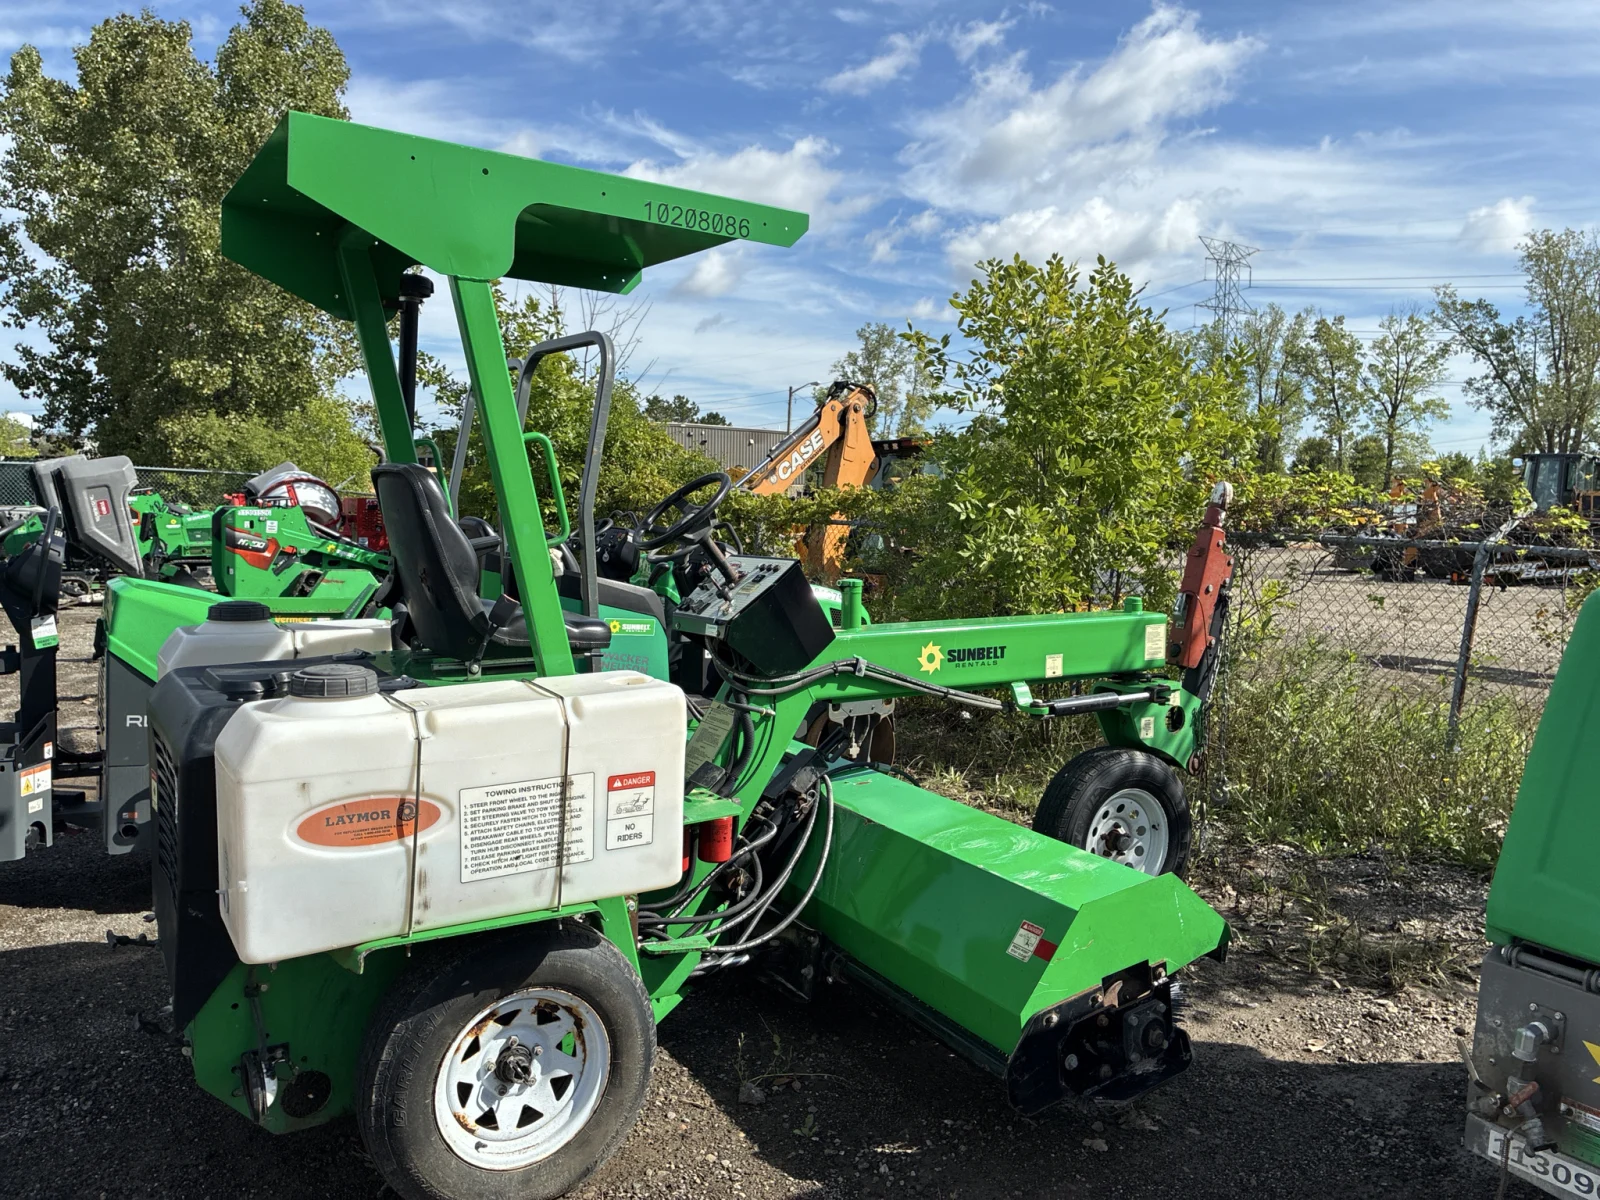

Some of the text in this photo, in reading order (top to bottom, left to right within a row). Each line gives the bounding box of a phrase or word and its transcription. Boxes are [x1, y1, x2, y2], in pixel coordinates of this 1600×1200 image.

[644, 200, 750, 238] 10208086
[778, 428, 824, 480] CASE
[1486, 562, 1544, 574] Eager
[1520, 567, 1589, 579] Beaver
[602, 652, 649, 664] WACKER
[947, 646, 1006, 663] SUNBELT
[955, 660, 998, 668] RENTALS
[623, 776, 650, 786] DANGER
[485, 788, 517, 797] TOWING
[325, 810, 391, 827] LAYMOR
[482, 812, 509, 820] STEERING
[471, 833, 505, 842] BREAKAWAY
[617, 832, 643, 842] RIDERS
[471, 839, 502, 848] DISENGAGE
[501, 840, 535, 850] DISCONNECT
[497, 849, 520, 857] PARKING
[470, 866, 502, 874] OPERATION
[1492, 1138, 1600, 1200] 11309
